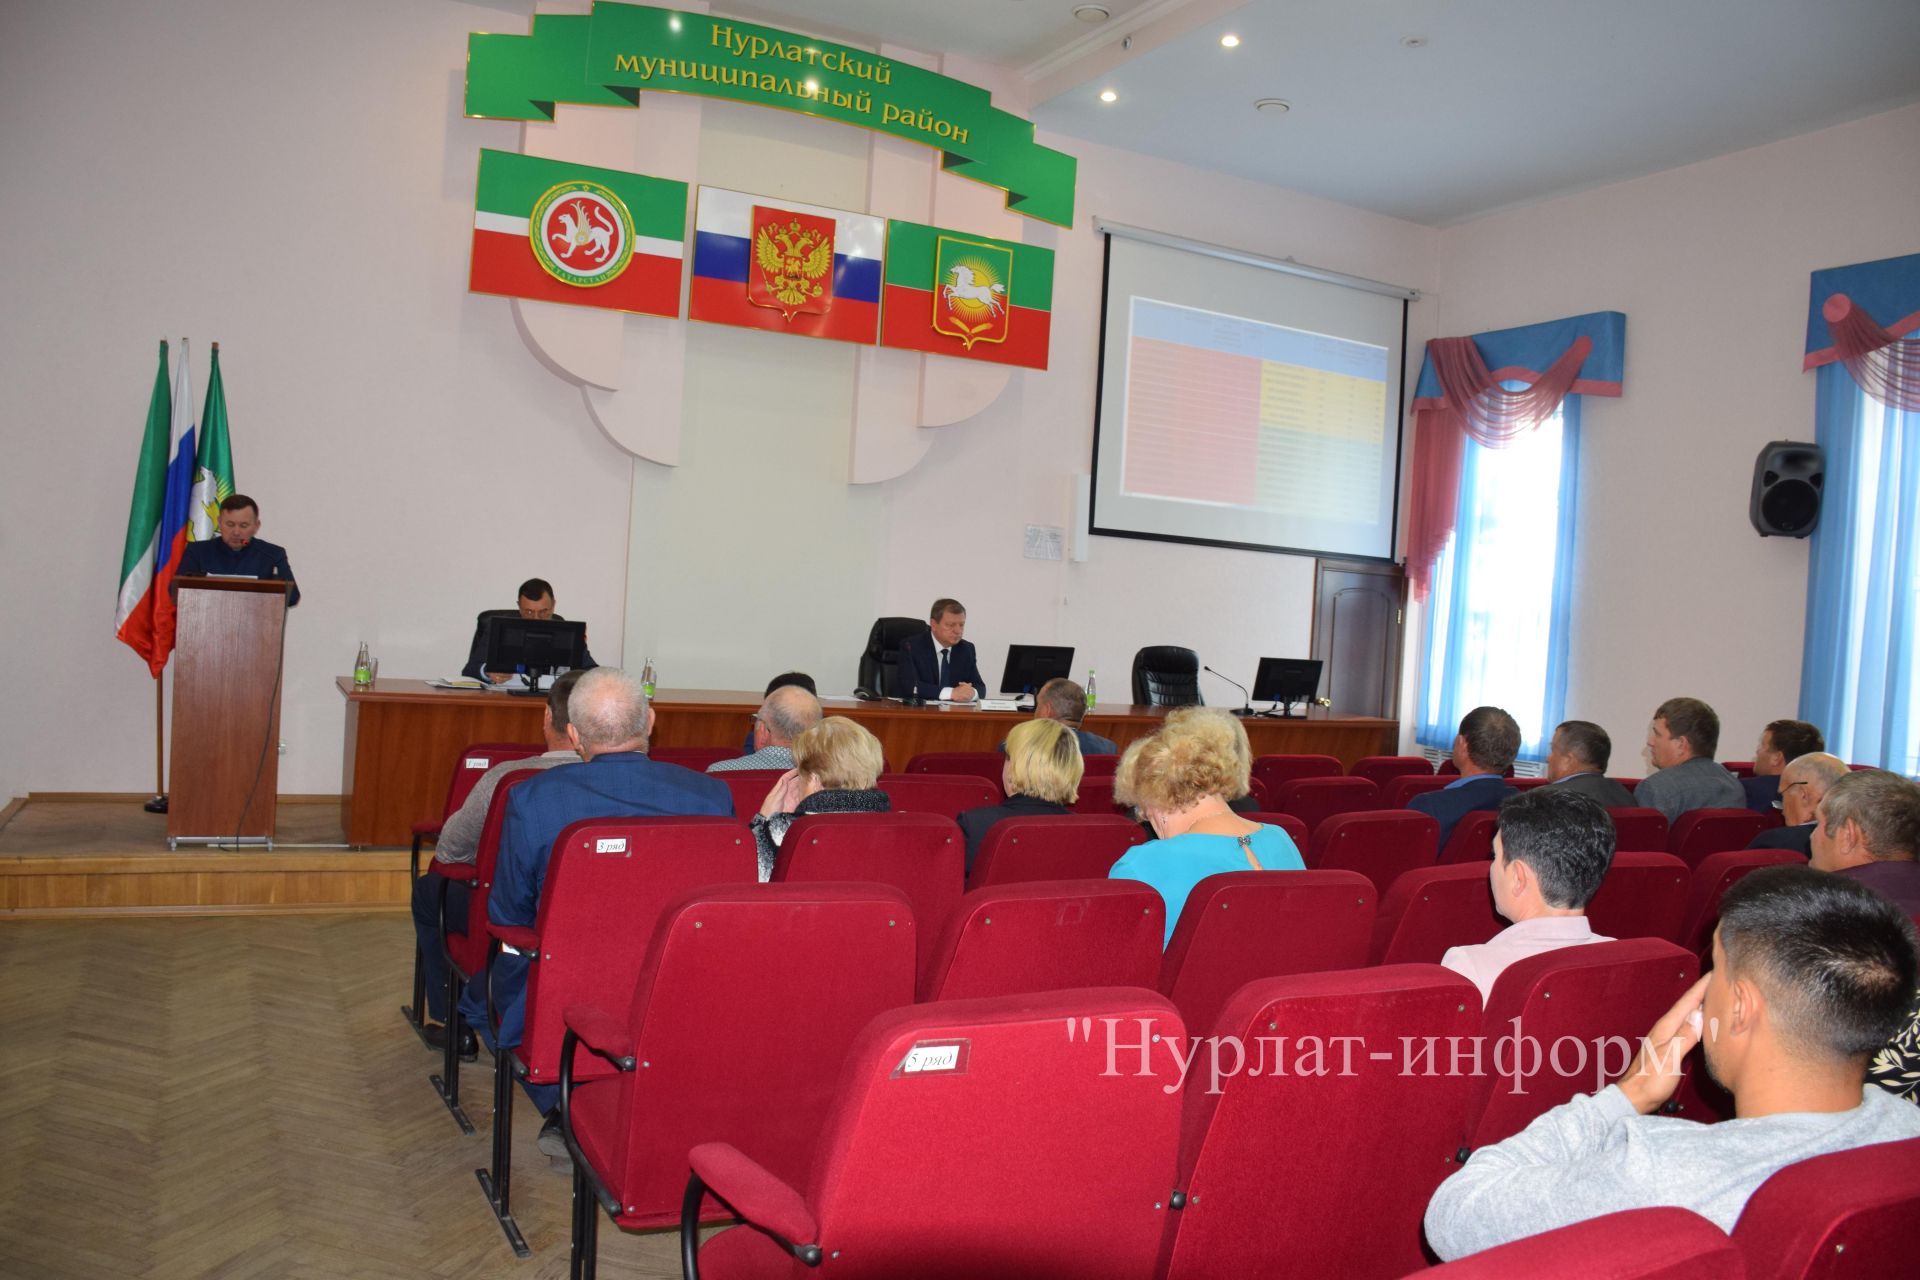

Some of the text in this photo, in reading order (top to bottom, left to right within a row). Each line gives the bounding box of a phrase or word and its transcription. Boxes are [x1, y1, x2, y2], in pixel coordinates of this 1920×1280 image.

[711, 24, 891, 85] Нурлатский
[614, 53, 970, 145] муниципальный район
[920, 1050, 953, 1071] ряд
